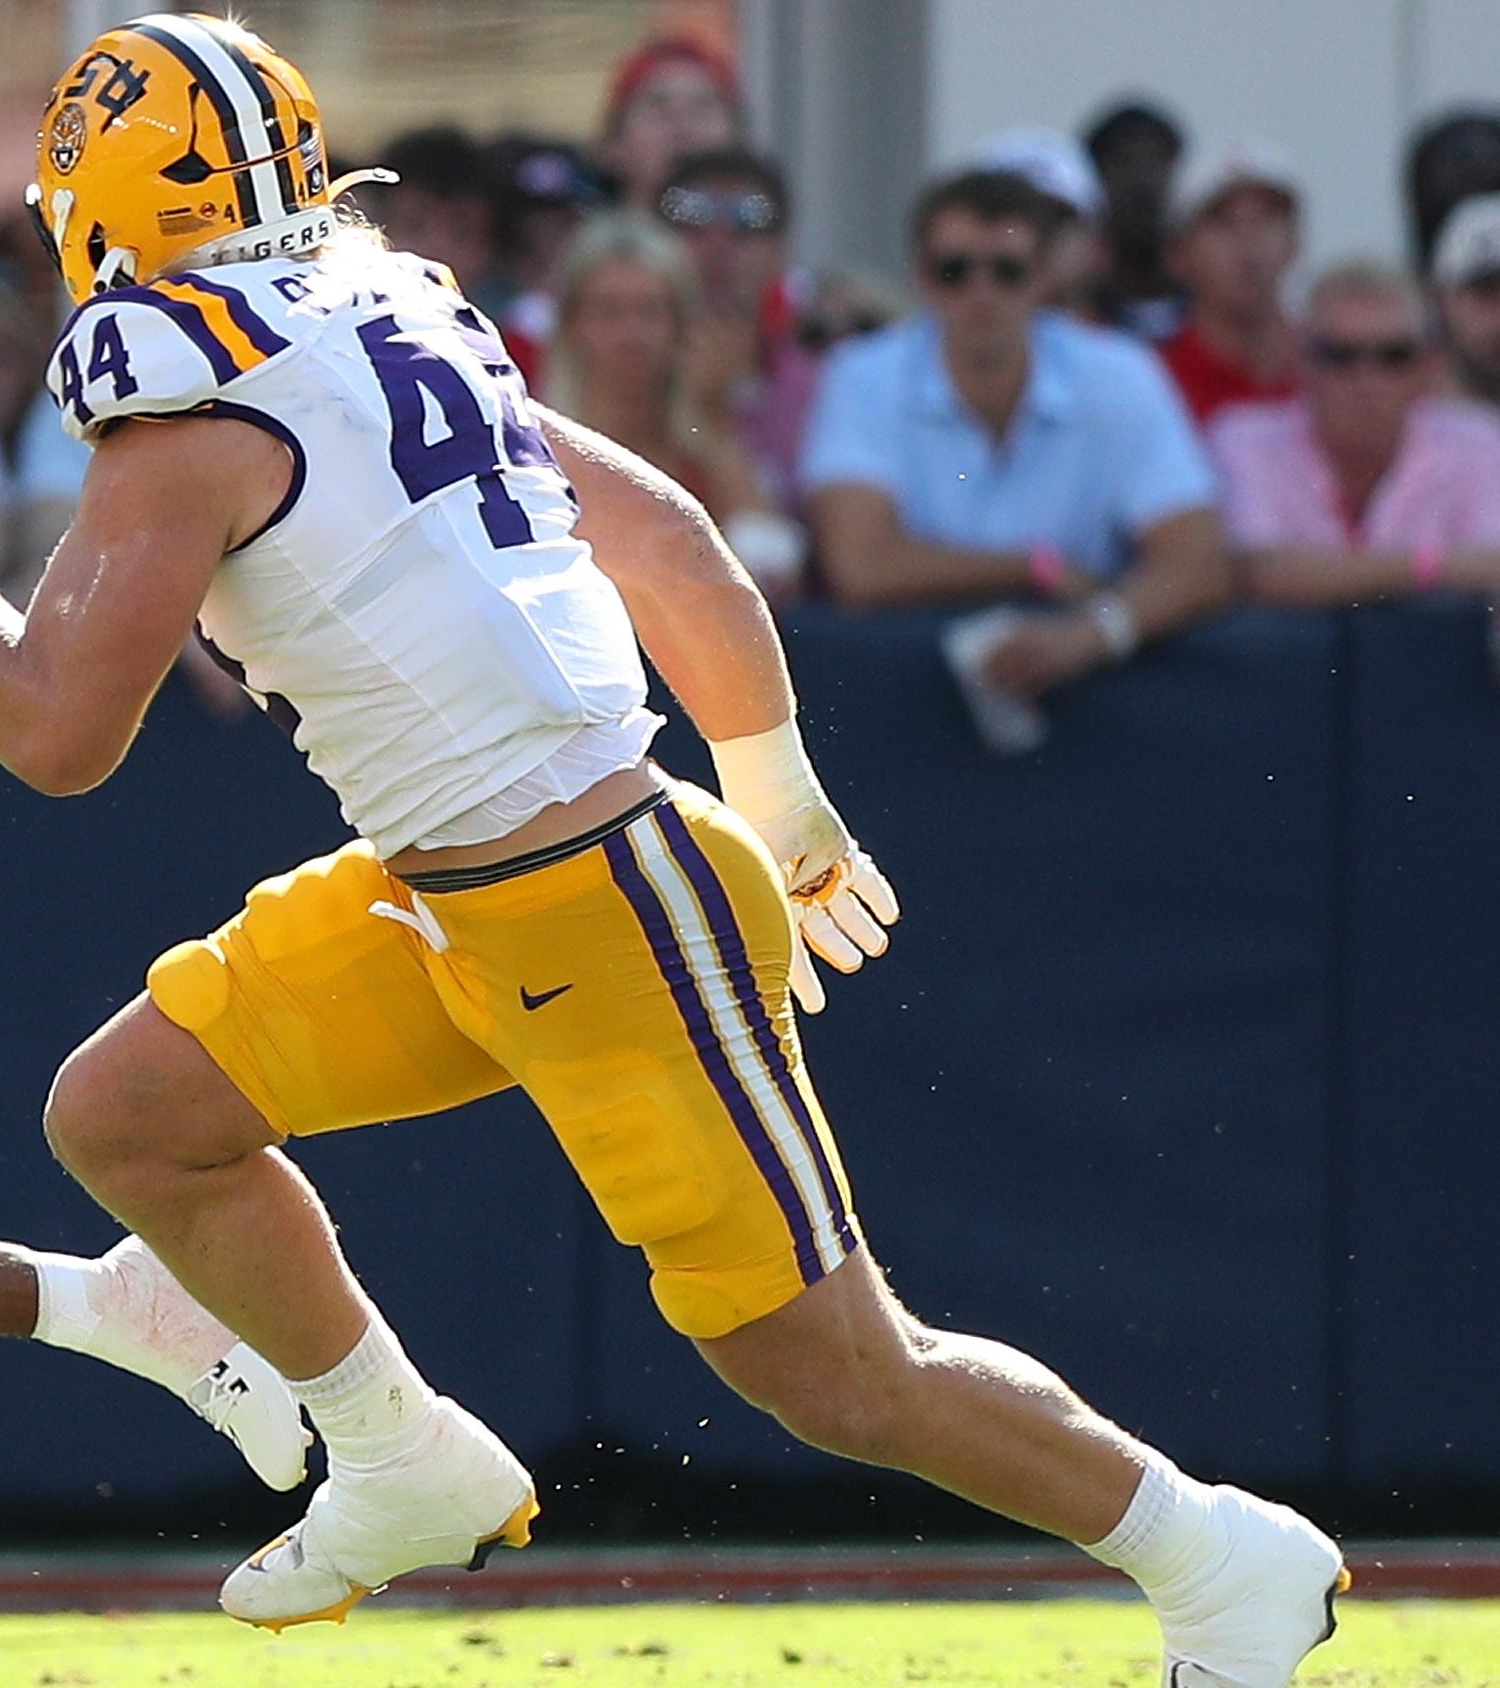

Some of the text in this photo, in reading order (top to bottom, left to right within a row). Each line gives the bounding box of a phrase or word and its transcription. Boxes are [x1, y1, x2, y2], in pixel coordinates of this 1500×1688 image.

[44, 49, 152, 136] SU
[210, 220, 331, 267] TIGERS
[223, 202, 238, 224] 4
[59, 312, 140, 426] 44
